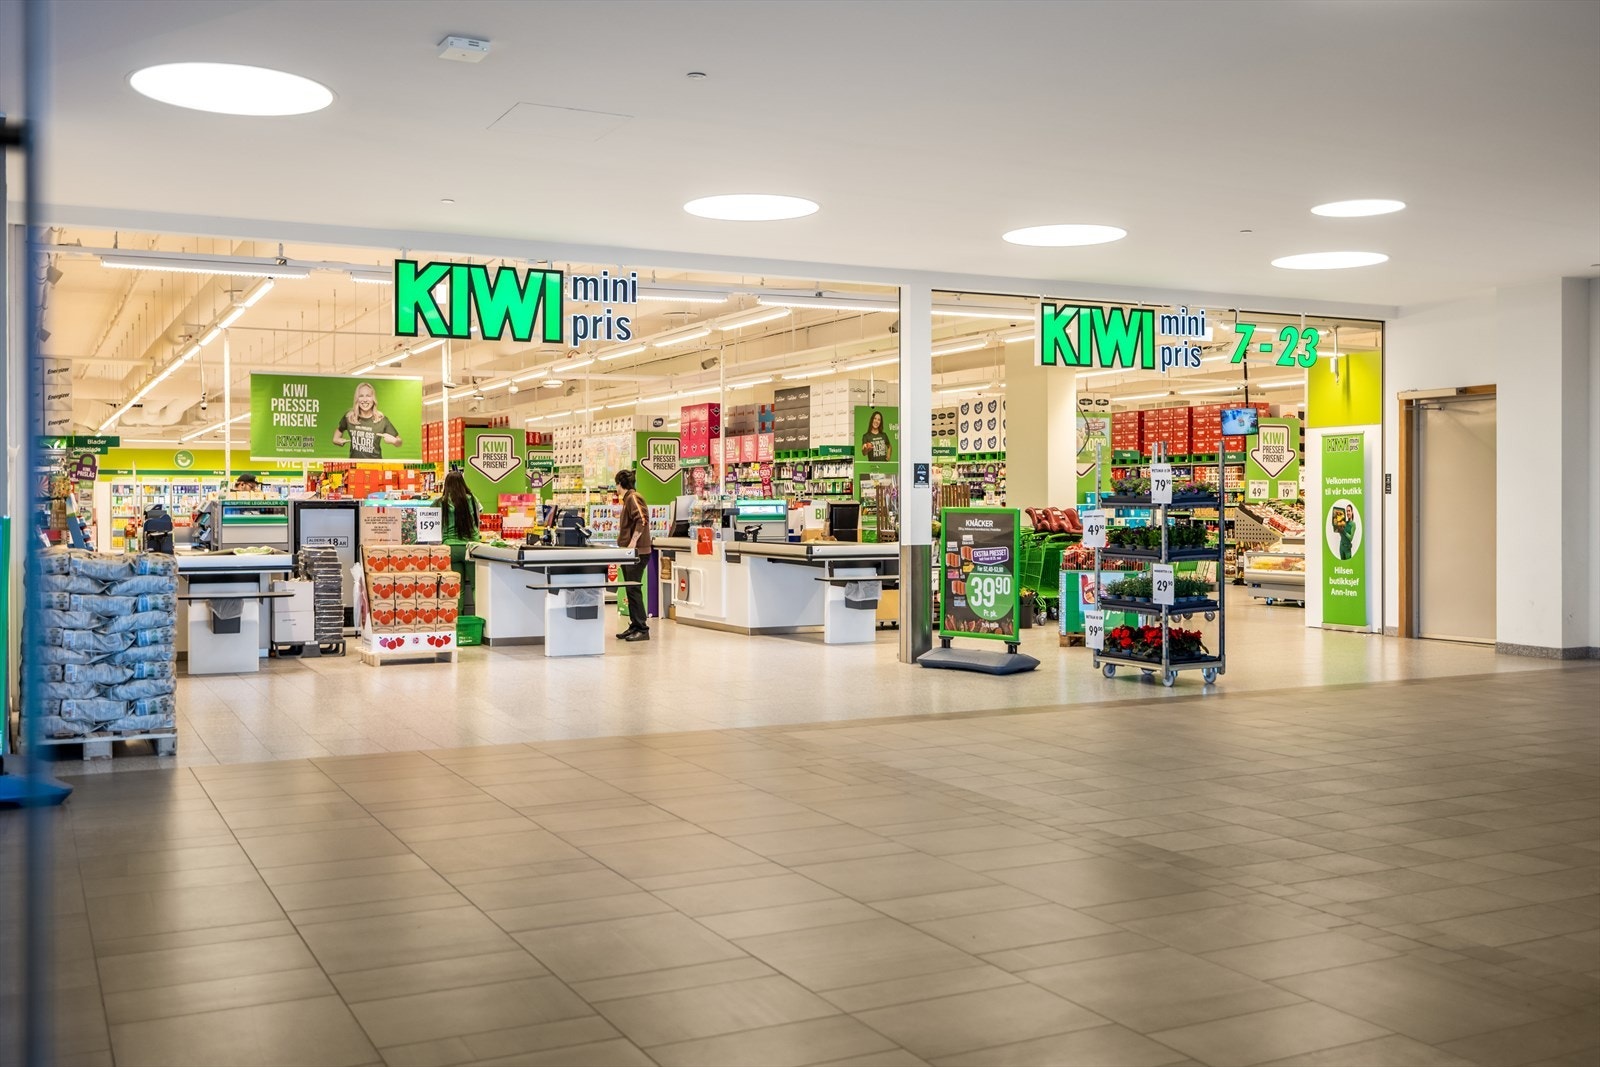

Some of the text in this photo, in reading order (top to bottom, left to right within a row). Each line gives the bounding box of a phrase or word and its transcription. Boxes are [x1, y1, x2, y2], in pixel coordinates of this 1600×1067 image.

[395, 259, 637, 343] KIWI mini
[572, 308, 632, 347] pris
[1041, 302, 1206, 370] KIWI mini
[1276, 325, 1320, 368] 23
[1160, 340, 1202, 372] pris
[283, 384, 308, 397] KIWI
[271, 398, 319, 412] PRESSER
[273, 413, 317, 427] PRISENE
[1263, 432, 1284, 444] KIWI
[483, 441, 507, 452] KIWI
[653, 444, 675, 454] KIWI
[1263, 445, 1284, 453] PRESSER
[1326, 438, 1349, 452] KIWI
[1263, 455, 1284, 463] PRISENE!
[1326, 476, 1361, 484] Velkommen
[1333, 487, 1342, 495] vår
[1342, 487, 1362, 495] butikk
[327, 537, 339, 546] 18
[1334, 566, 1353, 575] Hilsen
[1329, 577, 1359, 587] butikksjef
[1331, 588, 1357, 597] Ann-Iren
